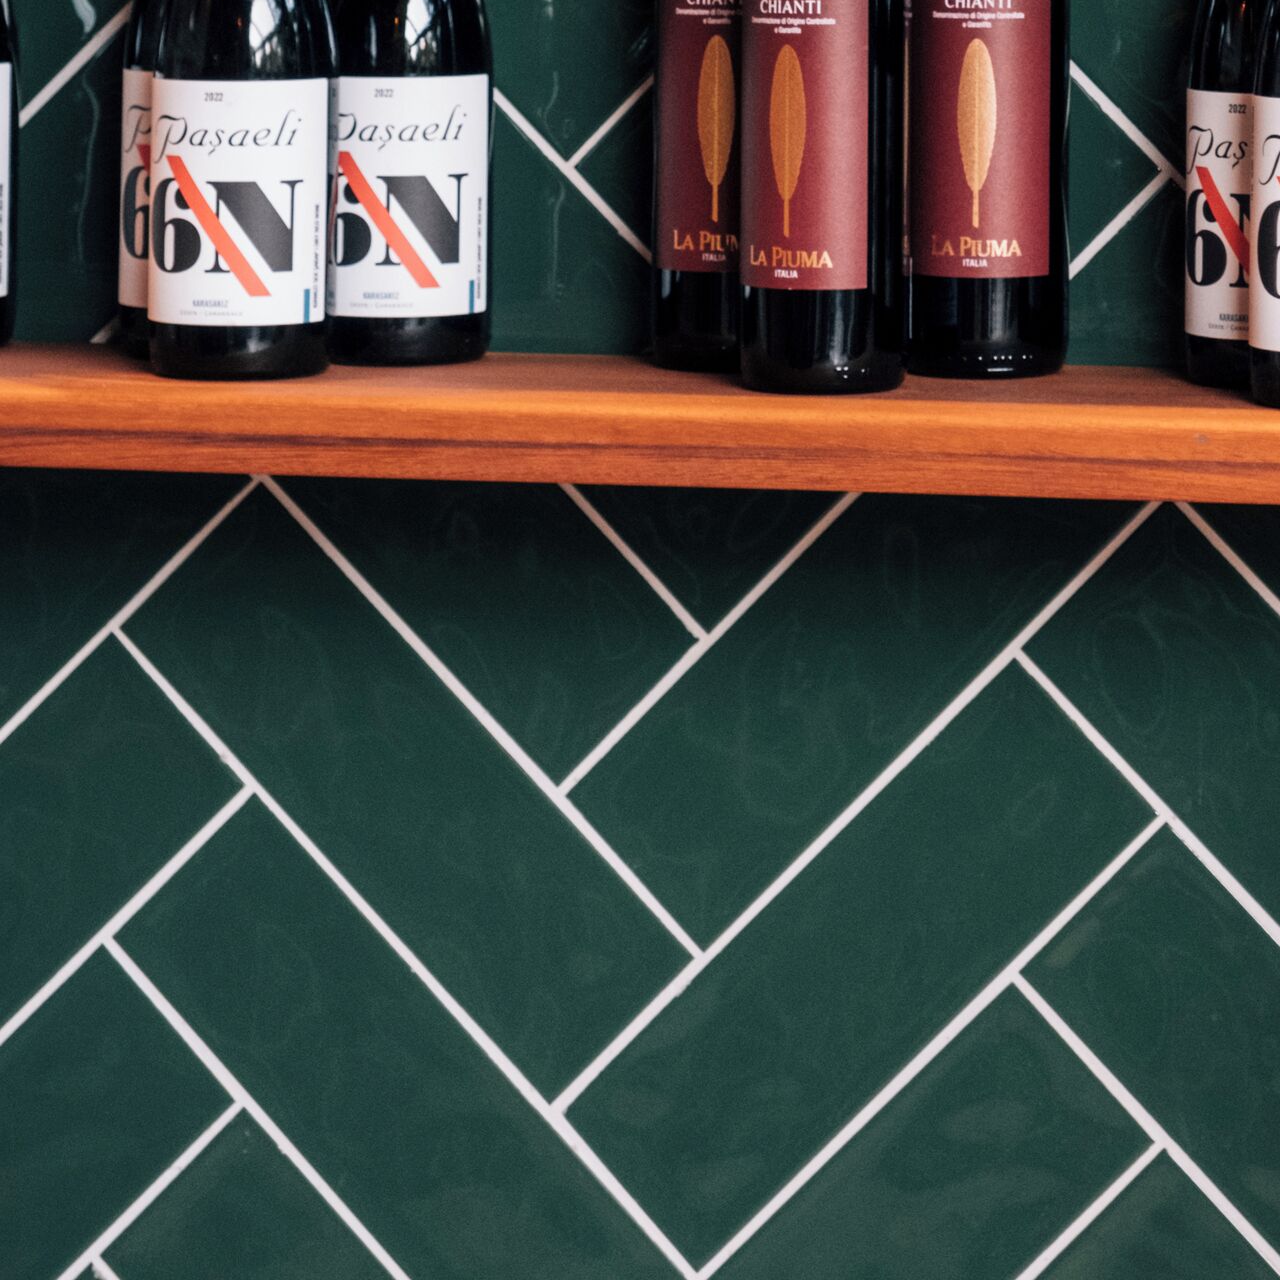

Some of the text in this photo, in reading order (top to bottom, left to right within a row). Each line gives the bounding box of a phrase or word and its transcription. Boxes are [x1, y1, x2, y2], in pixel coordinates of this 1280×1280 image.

[204, 91, 223, 102] 2022
[1228, 103, 1247, 114] 2022
[154, 108, 303, 164] Paşaeli
[673, 229, 694, 251] LA
[931, 234, 1022, 257] LA PIUMA
[750, 244, 833, 268] LA PIUMA
[962, 258, 988, 268] ITALIA
[774, 269, 798, 279] ITALIA
